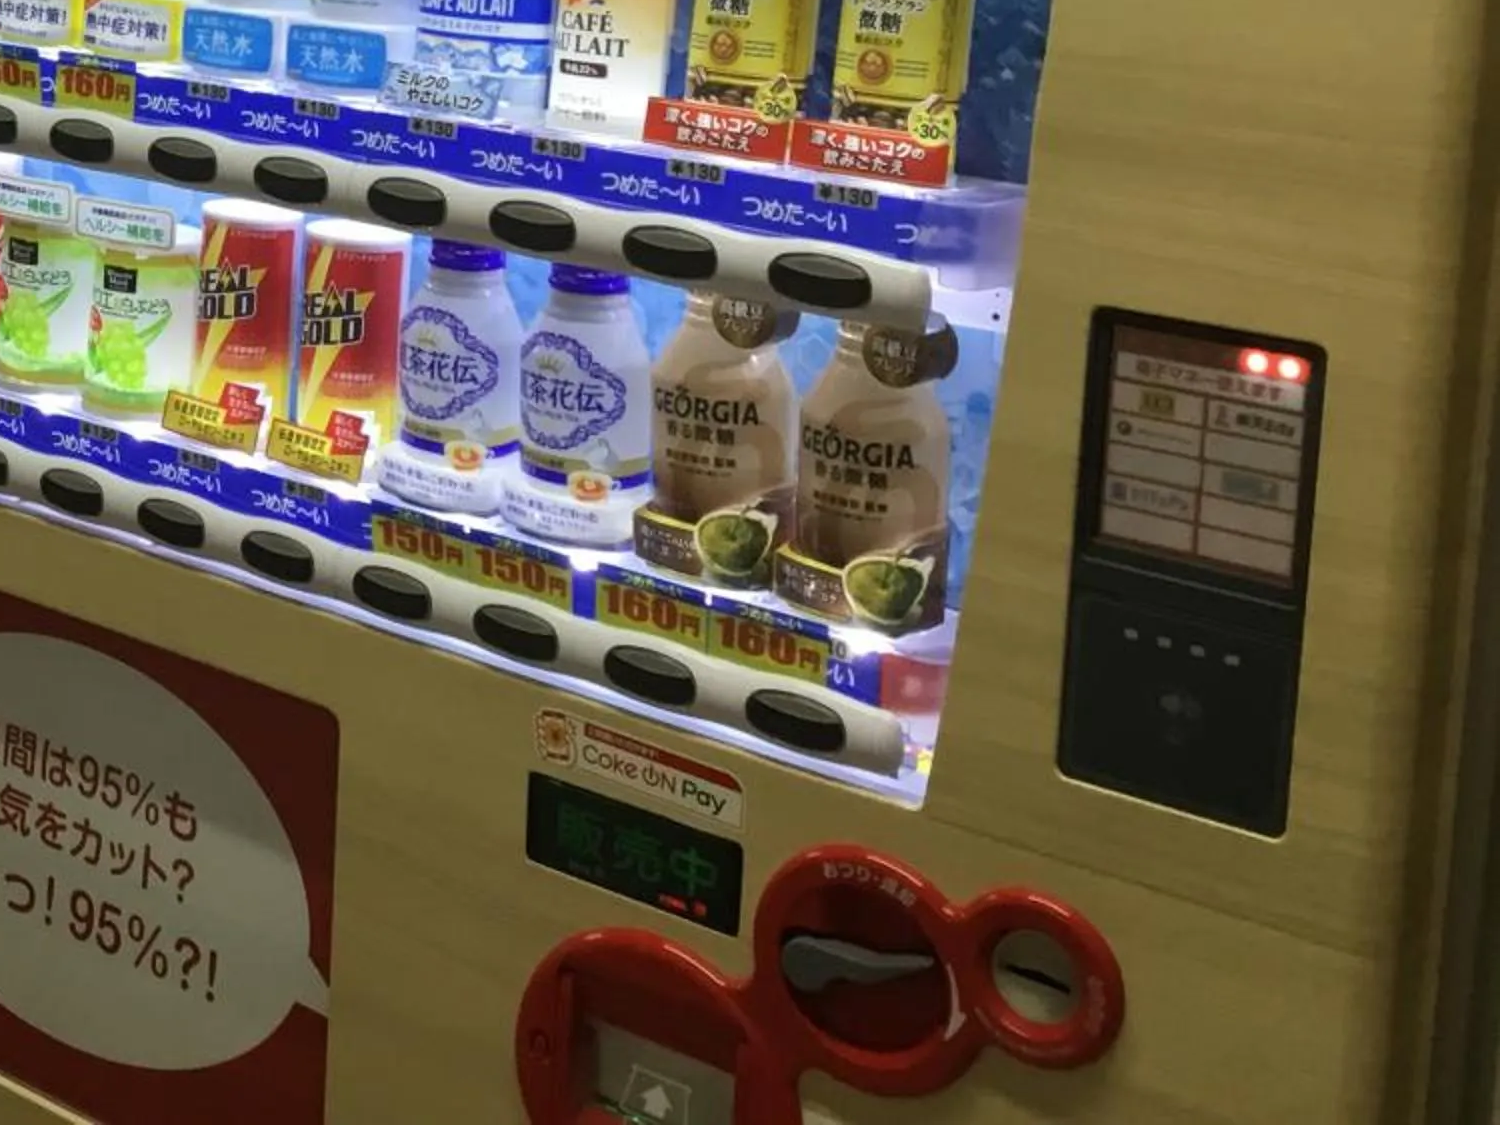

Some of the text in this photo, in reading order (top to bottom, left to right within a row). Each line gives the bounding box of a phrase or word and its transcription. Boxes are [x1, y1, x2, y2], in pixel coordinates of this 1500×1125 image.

[858, 10, 903, 34] 微糖
[195, 28, 253, 57] 天然水
[300, 45, 364, 74] 天然水
[575, 35, 630, 58] LAIT
[61, 62, 130, 102] 160円
[397, 72, 449, 89] ミルクの
[407, 88, 484, 112] やさしいコク
[654, 385, 760, 426] GEORGIA
[803, 425, 916, 468] GEORGIA
[379, 519, 464, 566] 150円
[476, 549, 568, 598] 150円
[603, 583, 699, 638] 160円
[717, 621, 821, 675] 160円
[582, 744, 638, 778] Coke
[682, 780, 727, 815] Pay
